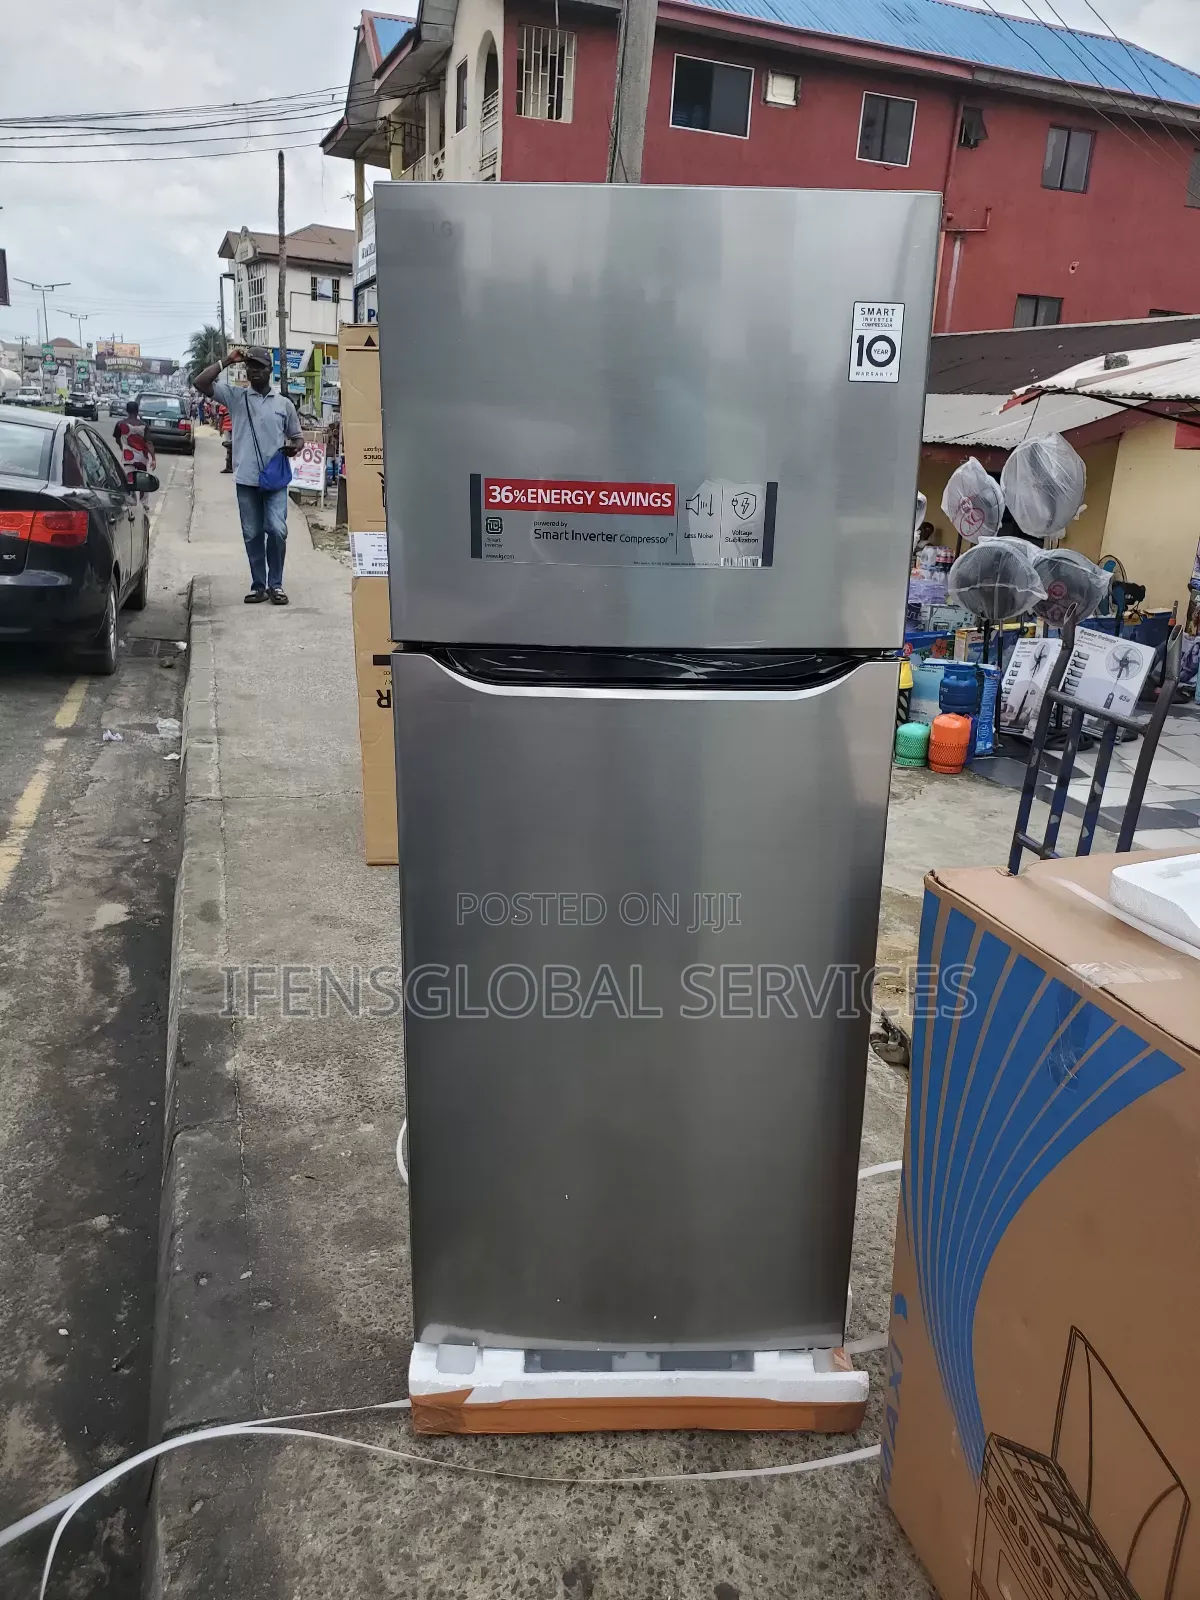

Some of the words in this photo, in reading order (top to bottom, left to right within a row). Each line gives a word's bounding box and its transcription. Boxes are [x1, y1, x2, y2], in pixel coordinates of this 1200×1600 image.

[860, 307, 896, 316] SMART
[856, 334, 897, 367] 10
[598, 490, 672, 508] SAVINGS
[533, 528, 569, 541] Smart
[571, 529, 618, 543] Inverter
[732, 529, 753, 538] Voltage
